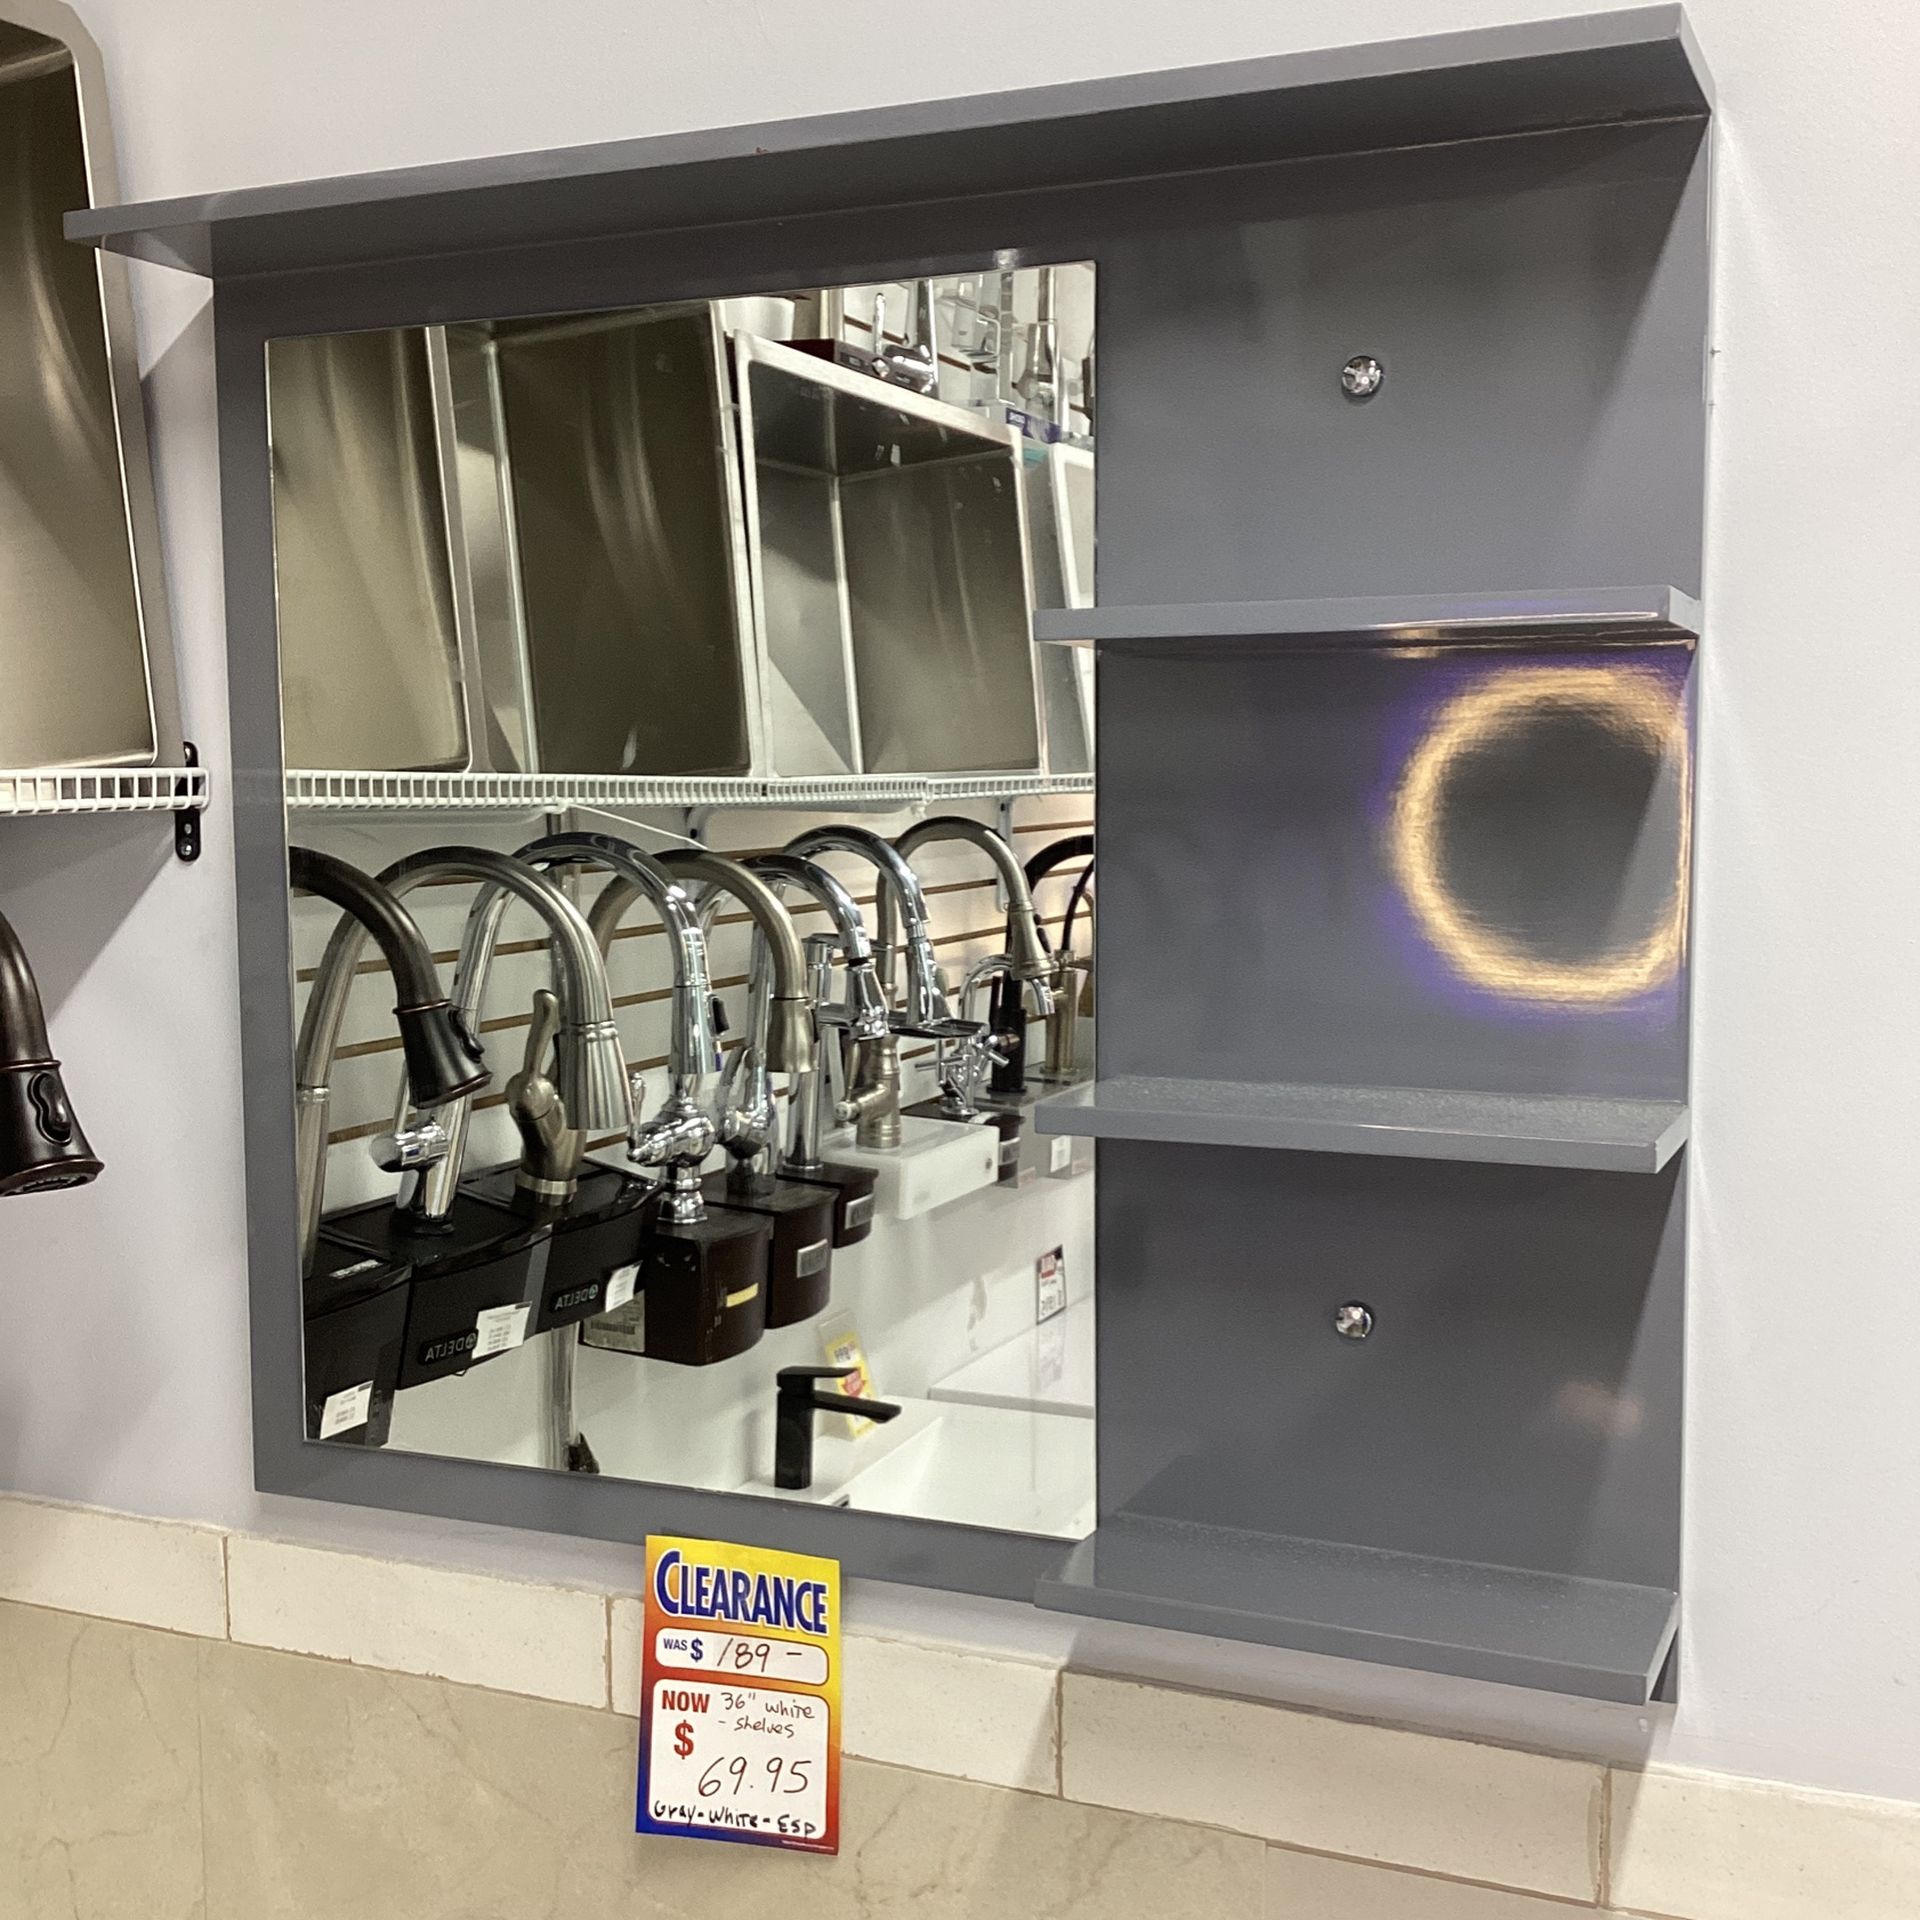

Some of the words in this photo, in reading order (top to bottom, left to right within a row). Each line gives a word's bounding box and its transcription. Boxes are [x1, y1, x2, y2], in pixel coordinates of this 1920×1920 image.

[655, 1549, 828, 1634] CLEARANCE
[663, 1637, 688, 1652] WAS
[661, 1689, 710, 1714] NOW
[698, 1756, 813, 1797] 69.95
